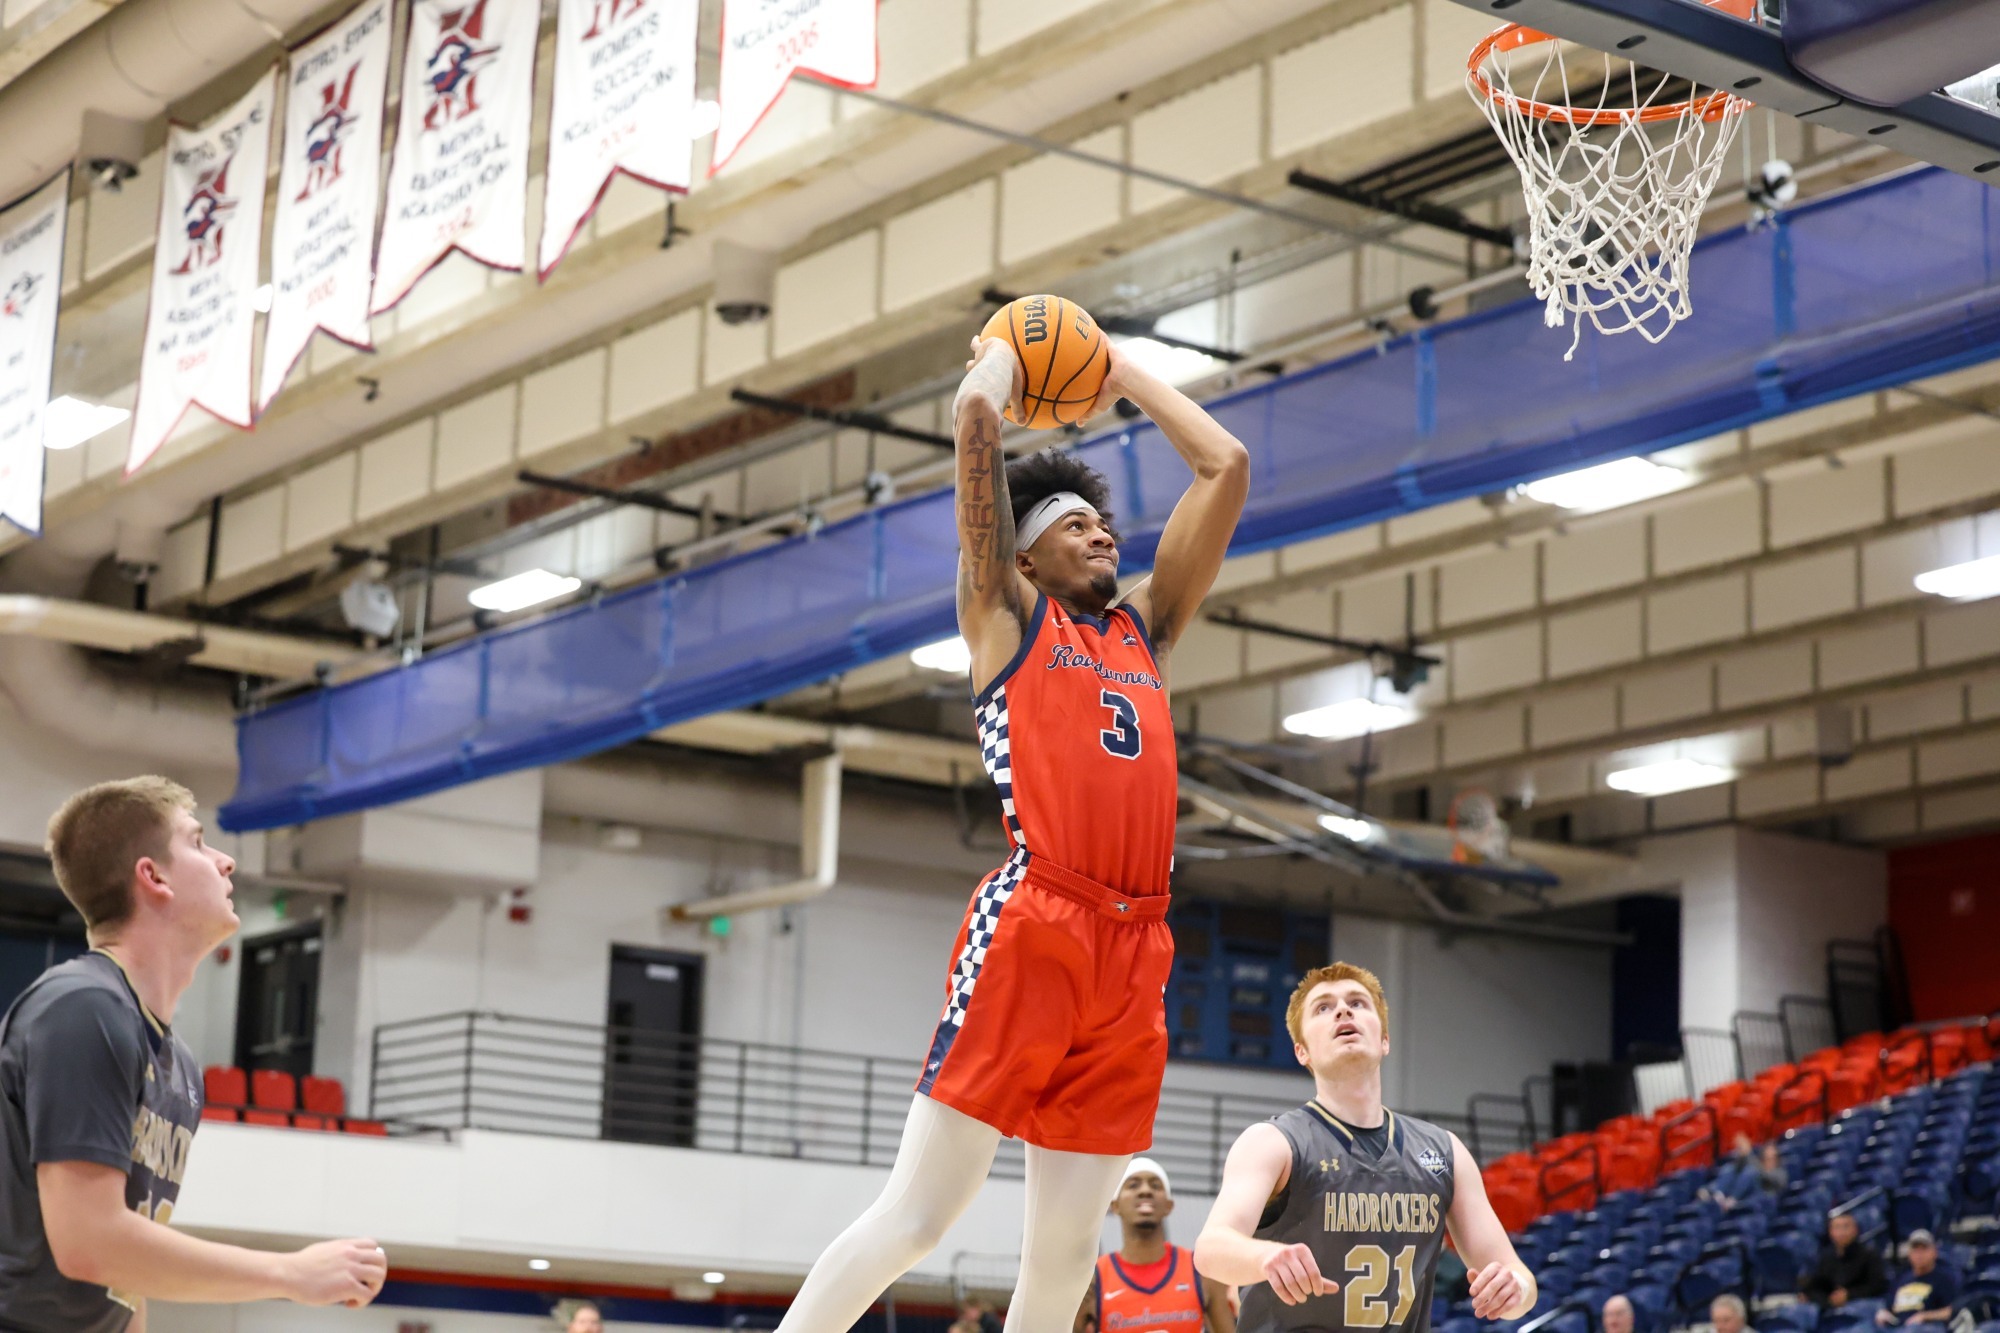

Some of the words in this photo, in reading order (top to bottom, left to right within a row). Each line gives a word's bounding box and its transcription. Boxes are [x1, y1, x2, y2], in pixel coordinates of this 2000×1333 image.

[1100, 688, 1142, 760] 3
[1324, 1191, 1441, 1234] HARDROCKERS
[1343, 1245, 1417, 1328] 21
